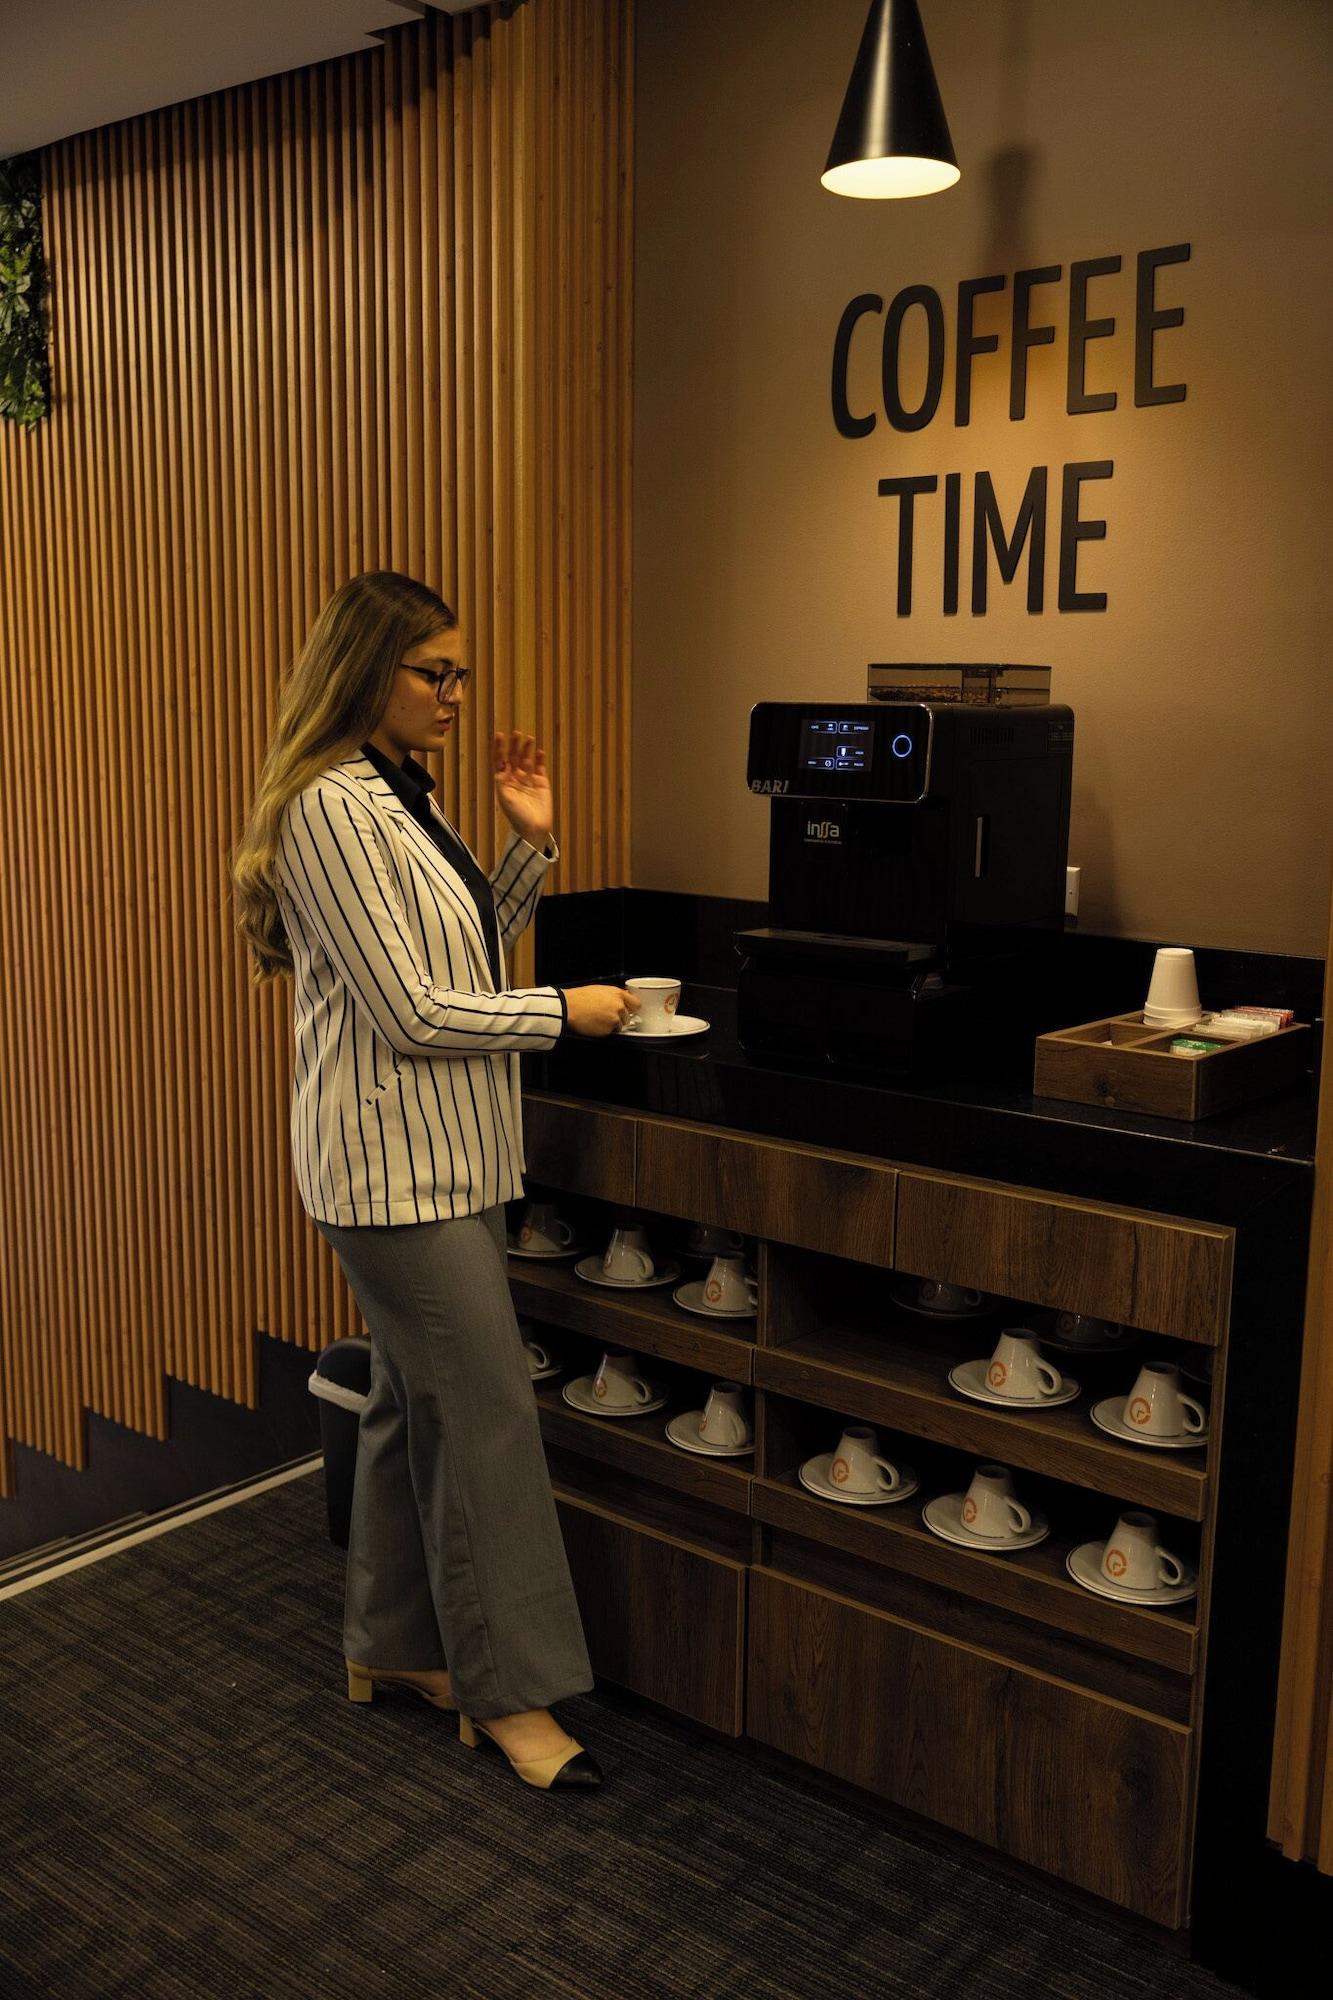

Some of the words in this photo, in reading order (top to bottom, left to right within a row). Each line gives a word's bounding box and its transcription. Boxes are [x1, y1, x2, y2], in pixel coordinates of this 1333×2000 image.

[831, 243, 1191, 438] COFFEE
[878, 460, 1114, 618] TIME
[751, 779, 791, 793] BARI
